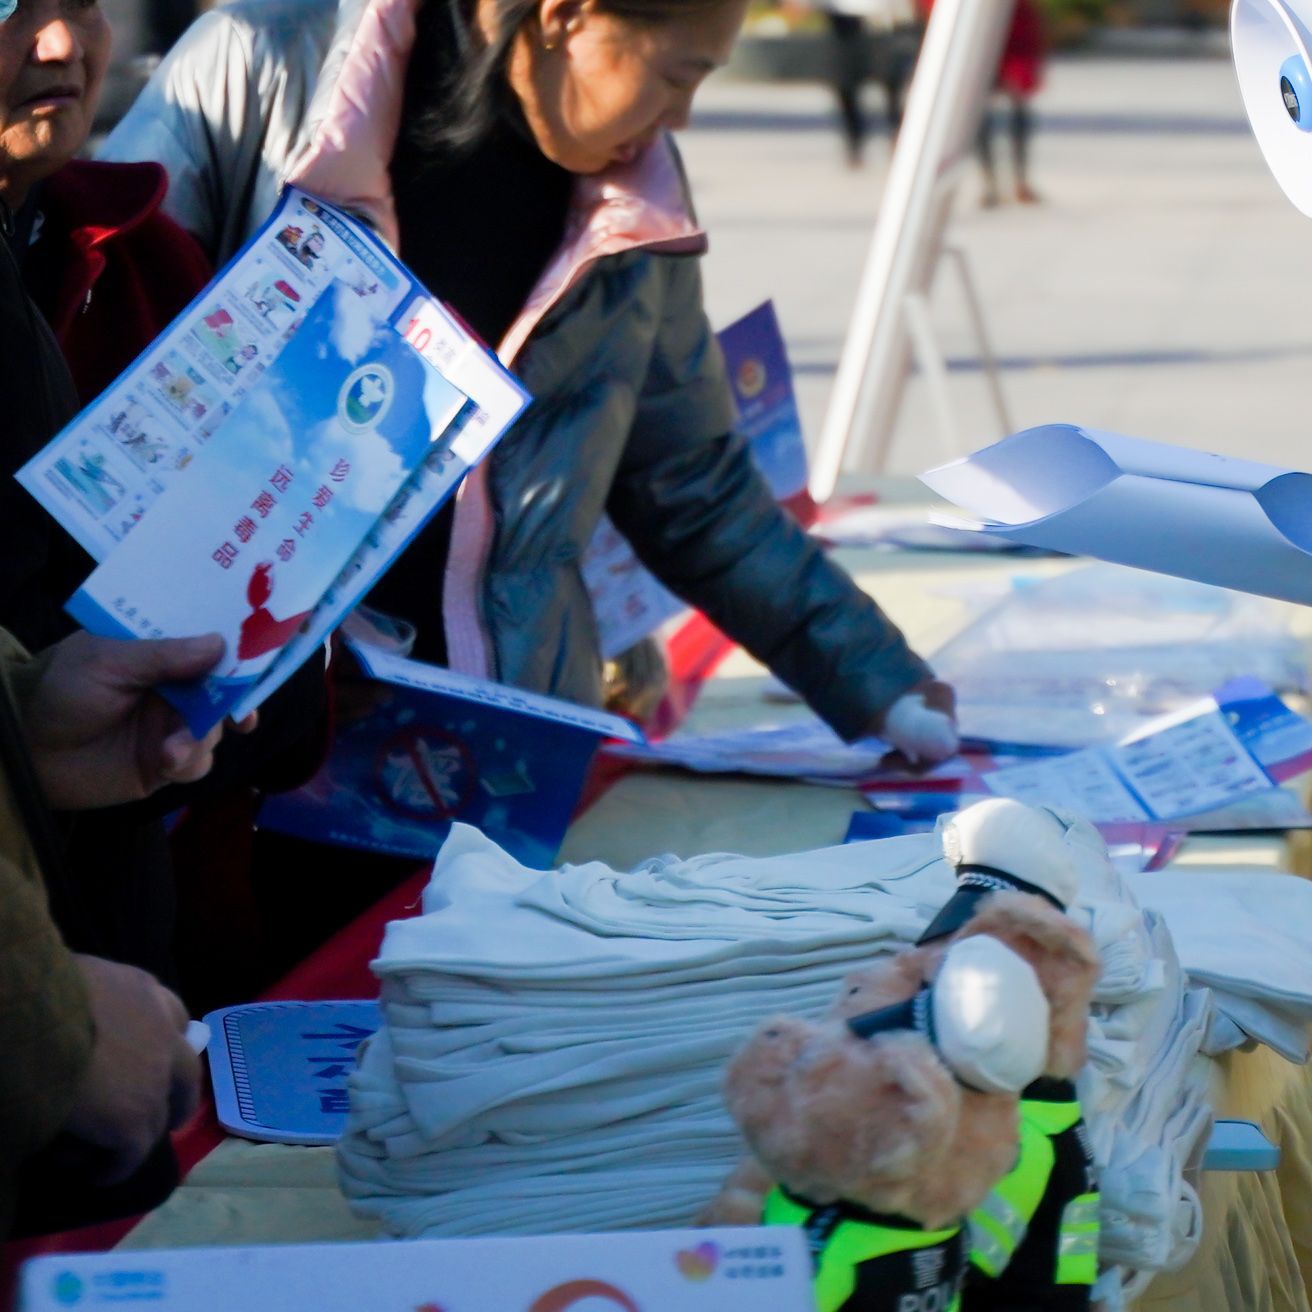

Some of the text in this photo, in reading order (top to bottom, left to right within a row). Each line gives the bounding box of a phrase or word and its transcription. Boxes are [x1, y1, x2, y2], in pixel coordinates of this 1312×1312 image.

[212, 464, 294, 570] 远离毒品
[276, 458, 350, 562] 珍爱生命
